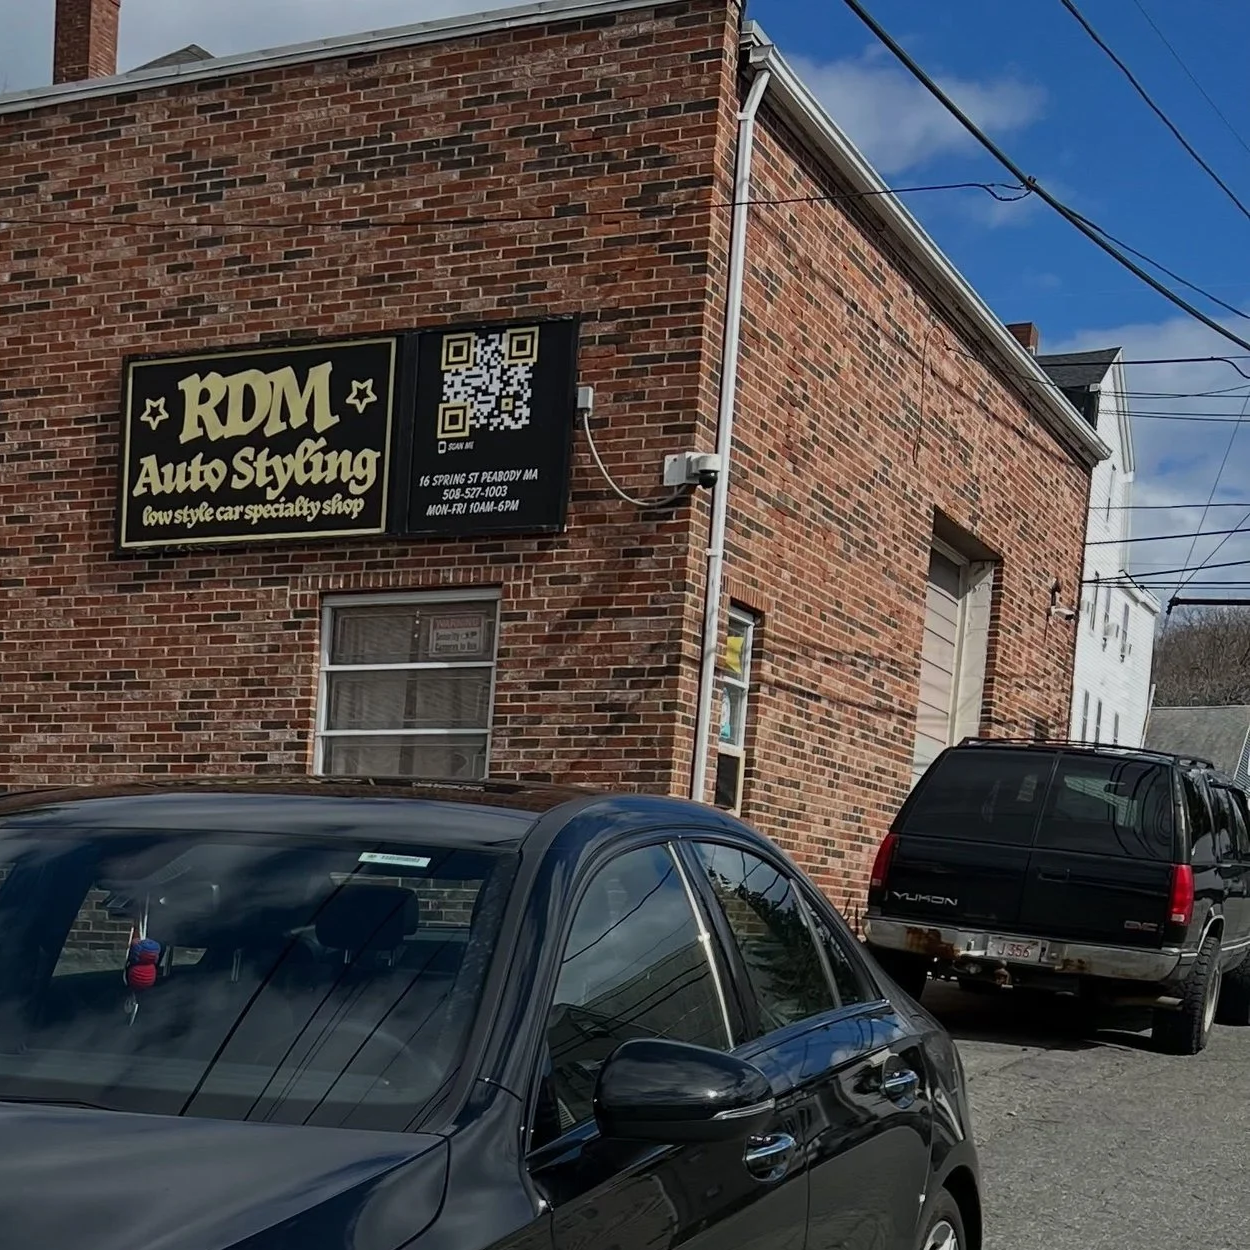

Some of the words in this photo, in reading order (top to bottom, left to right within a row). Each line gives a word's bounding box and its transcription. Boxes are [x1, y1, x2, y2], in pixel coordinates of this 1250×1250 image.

[177, 361, 340, 444] RDM
[132, 452, 228, 497] Auto
[230, 436, 381, 500] Styling
[419, 475, 430, 487] 16
[432, 473, 466, 486] SPRING
[467, 472, 480, 484] ST
[480, 469, 522, 483] PEABODY
[522, 468, 538, 480] MA
[442, 486, 508, 500] 508-527-1003
[142, 505, 174, 527] low
[174, 501, 214, 529] style
[215, 504, 243, 521] car
[243, 496, 321, 525] specialty
[322, 493, 365, 520] shop
[426, 502, 467, 516] MON-FRI
[469, 499, 520, 514] 10AM-6PM
[893, 891, 958, 906] YUKON
